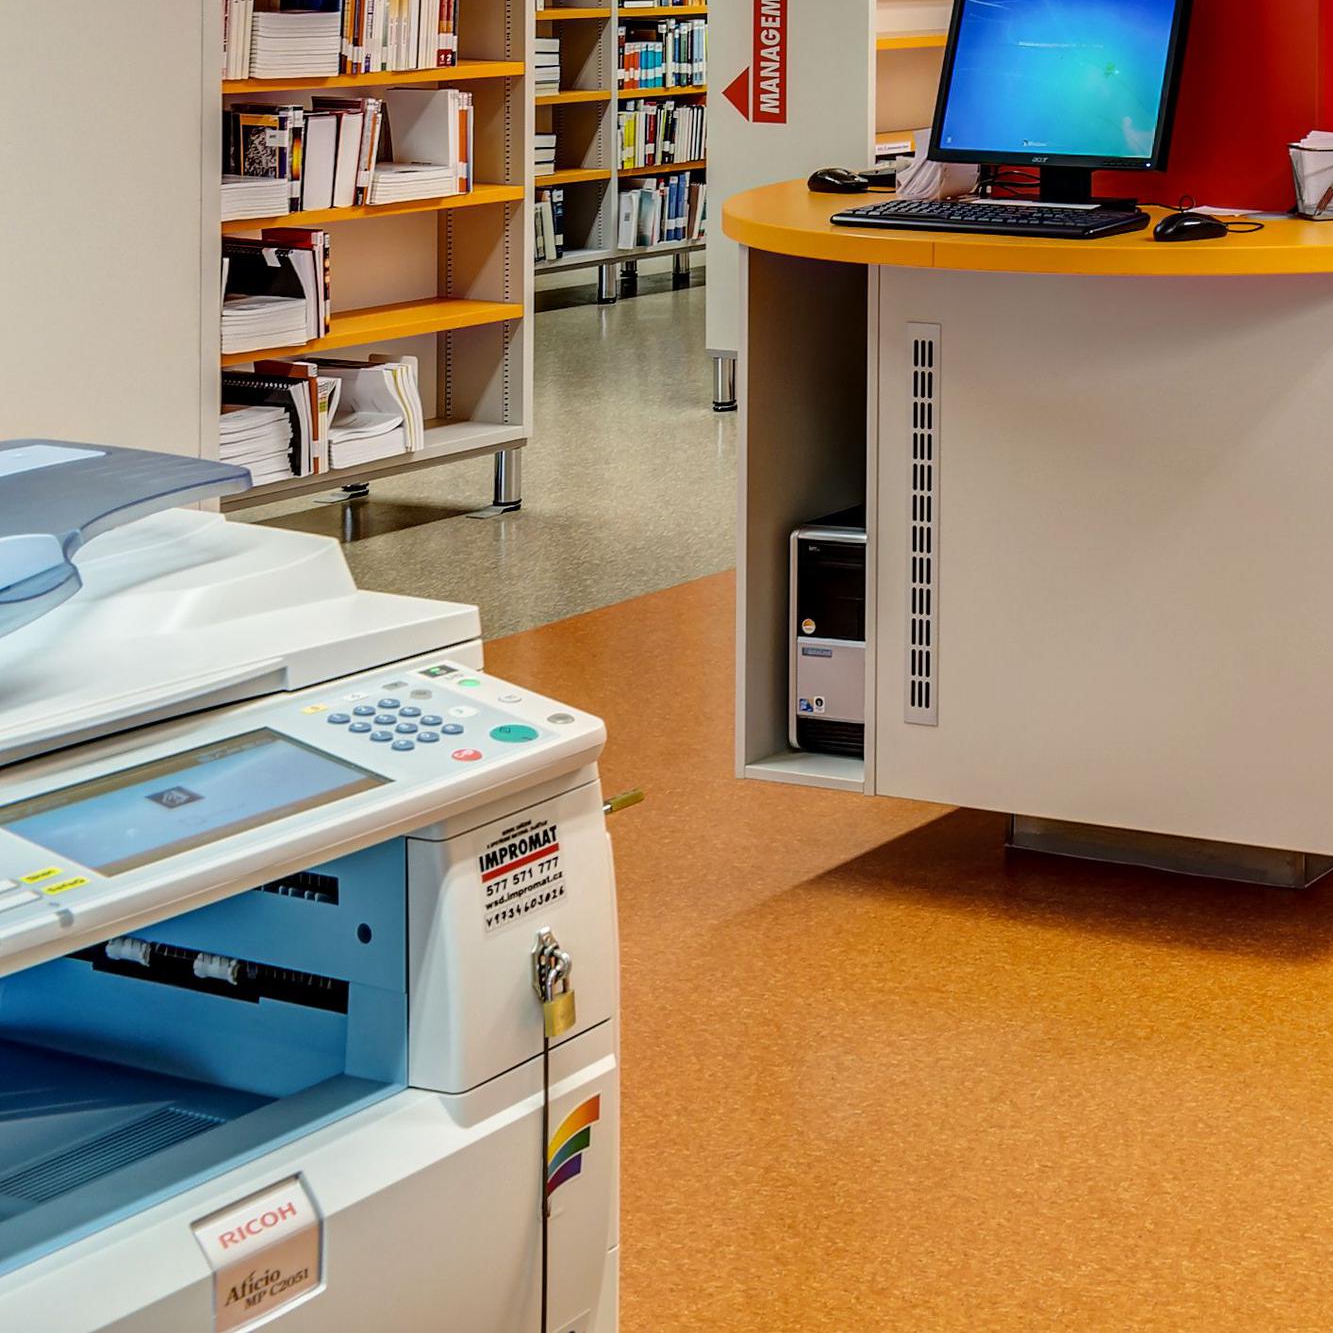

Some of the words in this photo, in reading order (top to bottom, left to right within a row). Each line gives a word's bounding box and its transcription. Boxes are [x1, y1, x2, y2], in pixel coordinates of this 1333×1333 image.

[479, 825, 557, 873] IMPROMAT
[485, 870, 563, 910] wsd.impromat.cz
[486, 878, 508, 896] 577
[513, 867, 533, 885] 571
[538, 856, 559, 873] 777
[218, 1202, 297, 1250] RICOH
[224, 1269, 281, 1307] Aficio
[244, 1289, 267, 1310] MP
[269, 1268, 309, 1297] C2051
